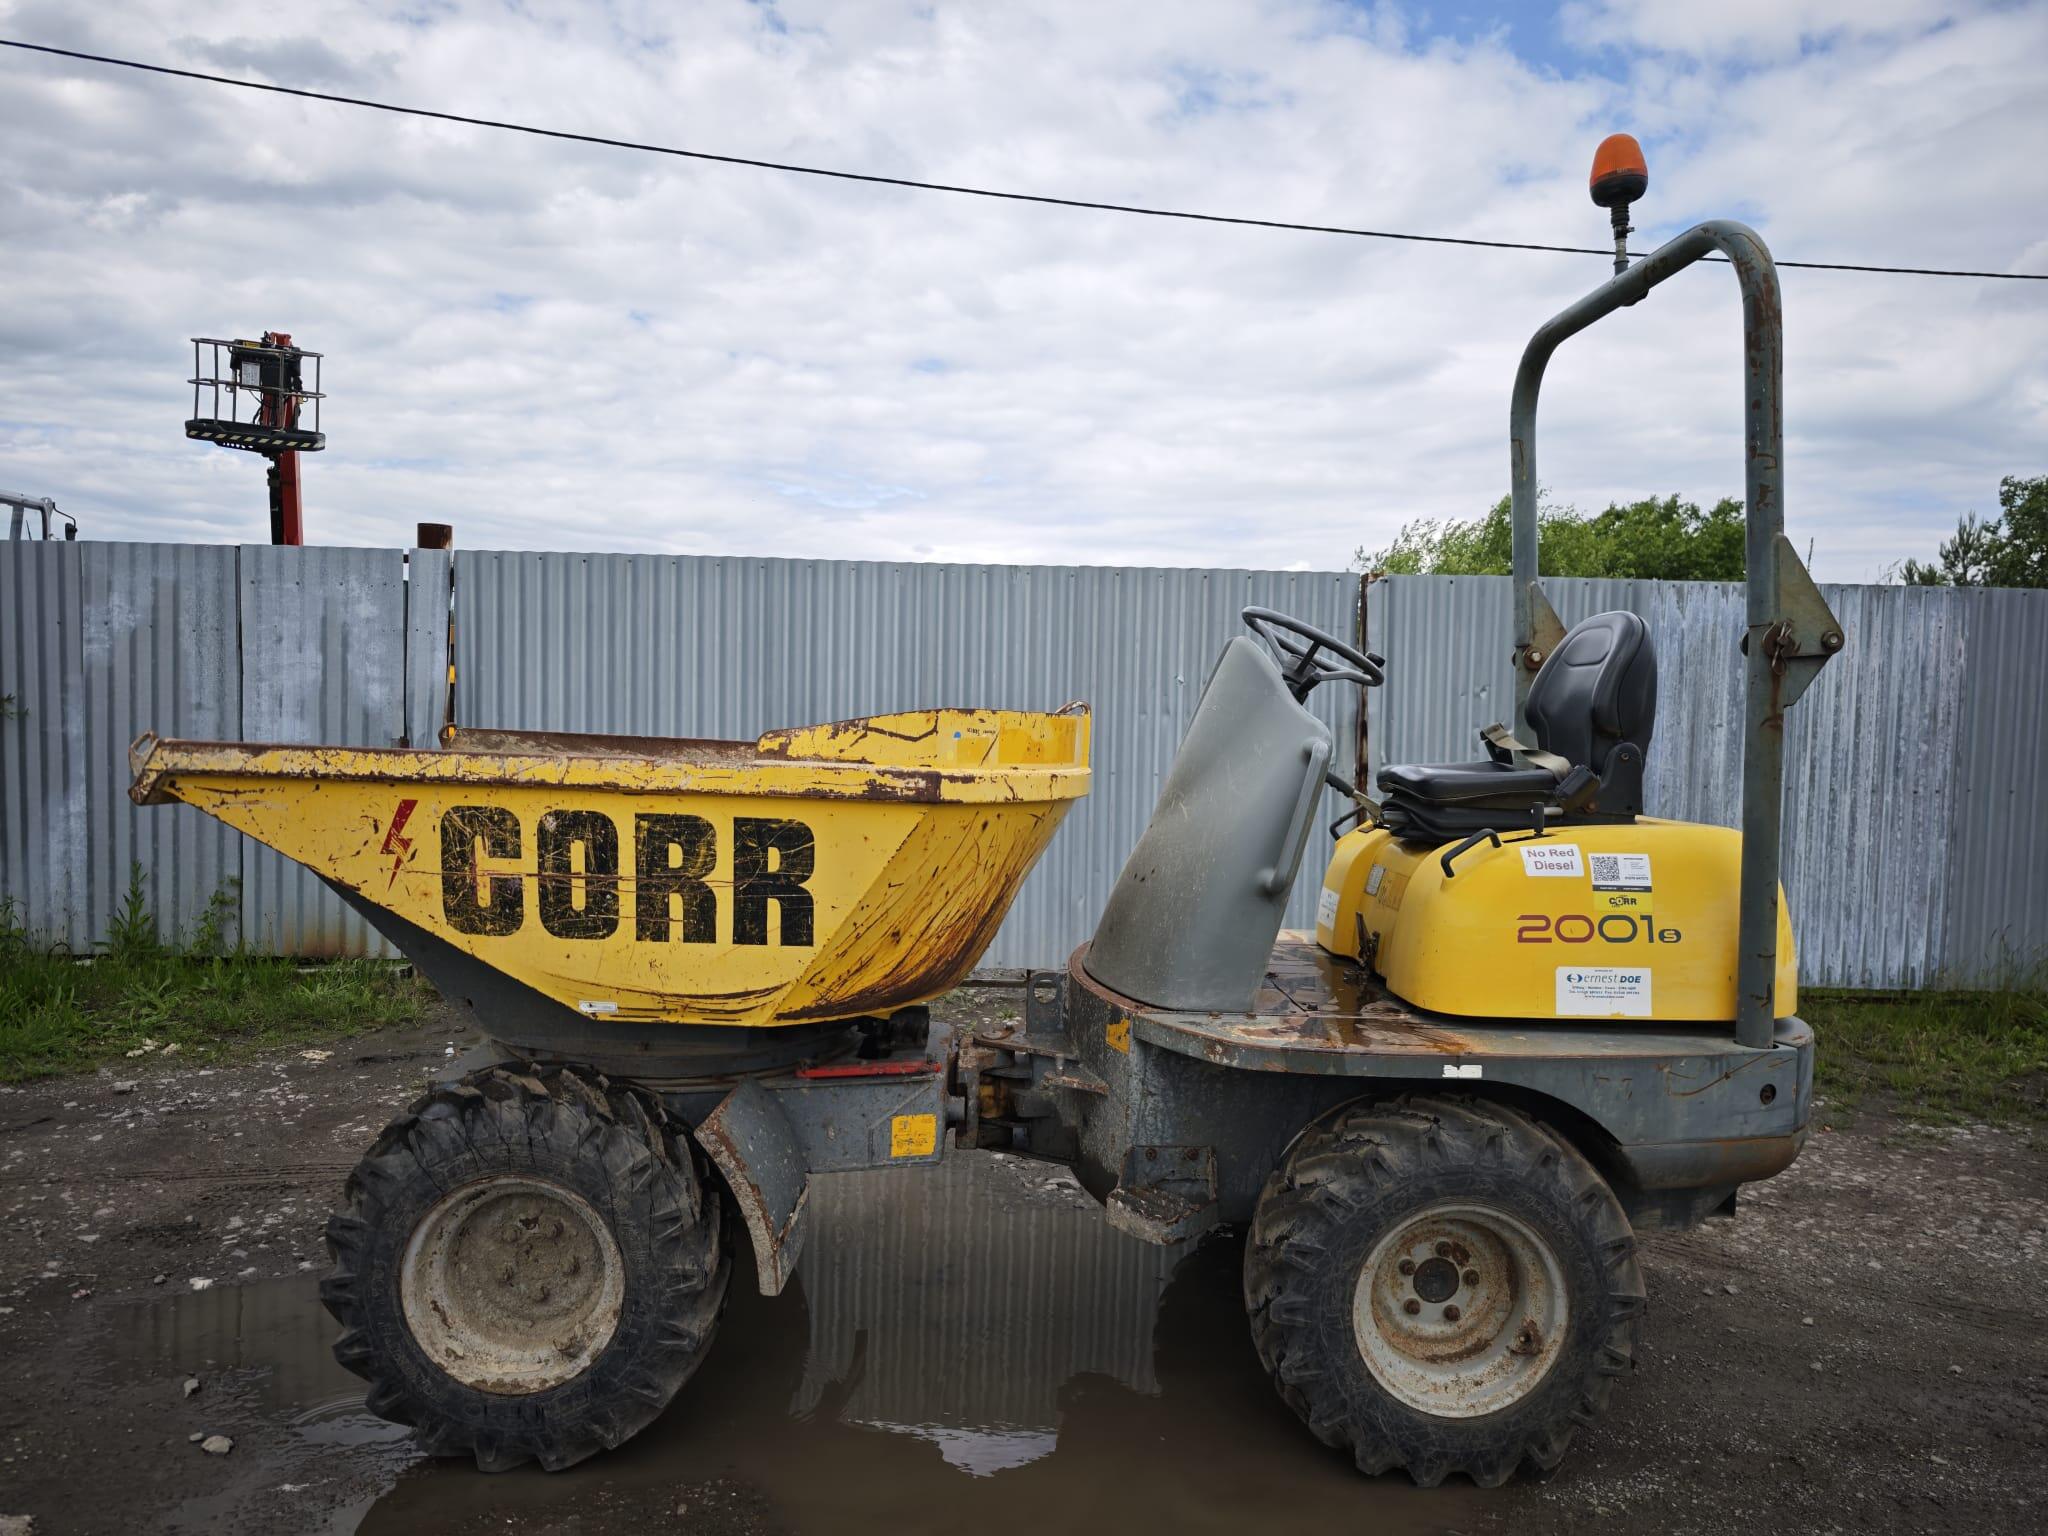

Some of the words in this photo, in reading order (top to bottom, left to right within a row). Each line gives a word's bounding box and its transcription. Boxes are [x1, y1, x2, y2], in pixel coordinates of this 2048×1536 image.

[1527, 849, 1546, 858] No
[1550, 848, 1575, 857] Red
[1534, 860, 1574, 871] Diesel
[440, 805, 815, 947] CORR
[1609, 896, 1637, 906] CORR
[1584, 974, 1618, 983] ernest
[1620, 975, 1642, 984] DOE
